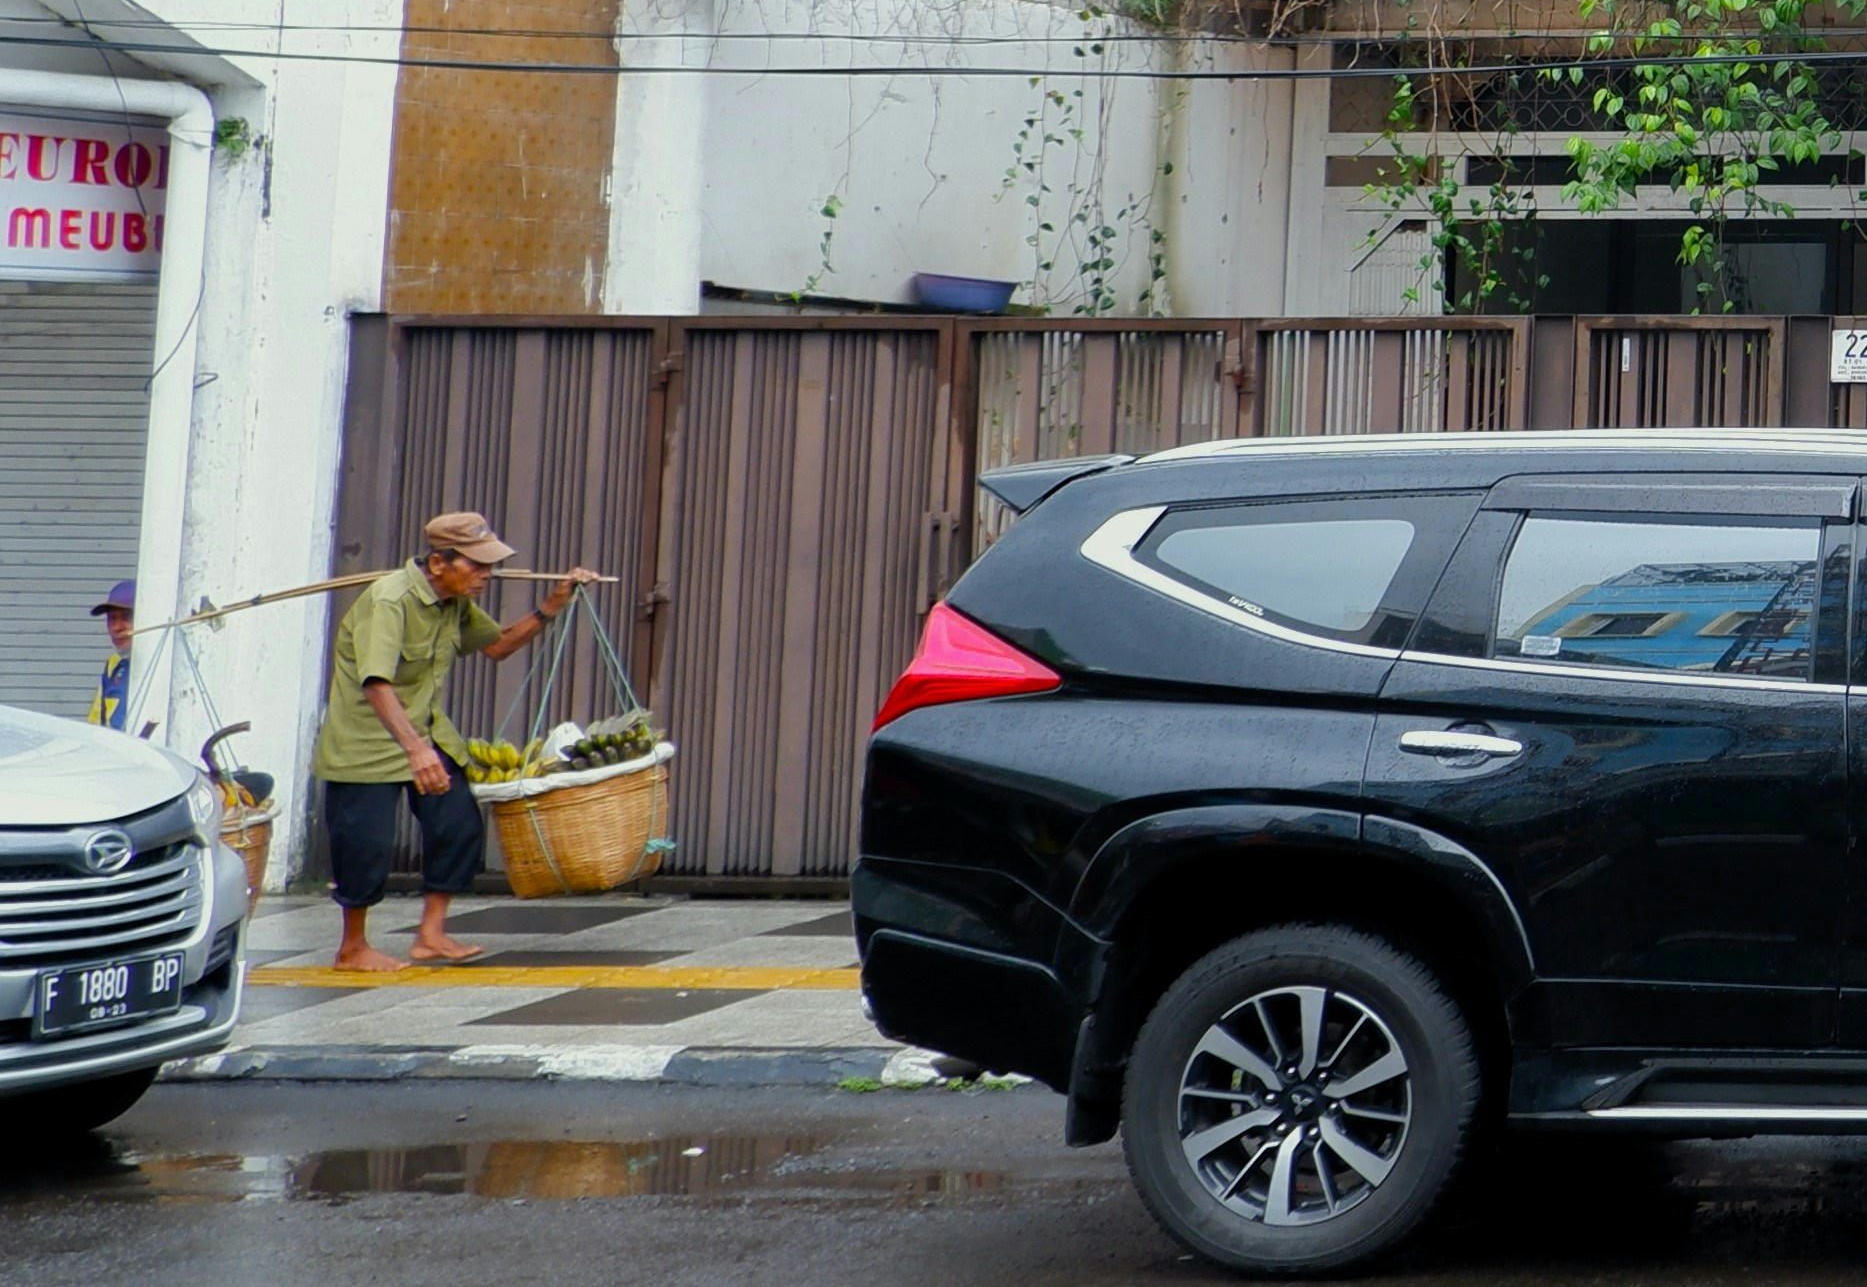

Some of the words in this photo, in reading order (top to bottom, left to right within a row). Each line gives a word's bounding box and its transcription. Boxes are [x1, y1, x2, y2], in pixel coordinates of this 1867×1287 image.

[46, 977, 59, 1011] F
[80, 965, 129, 1005] 1880
[152, 958, 179, 993] BP
